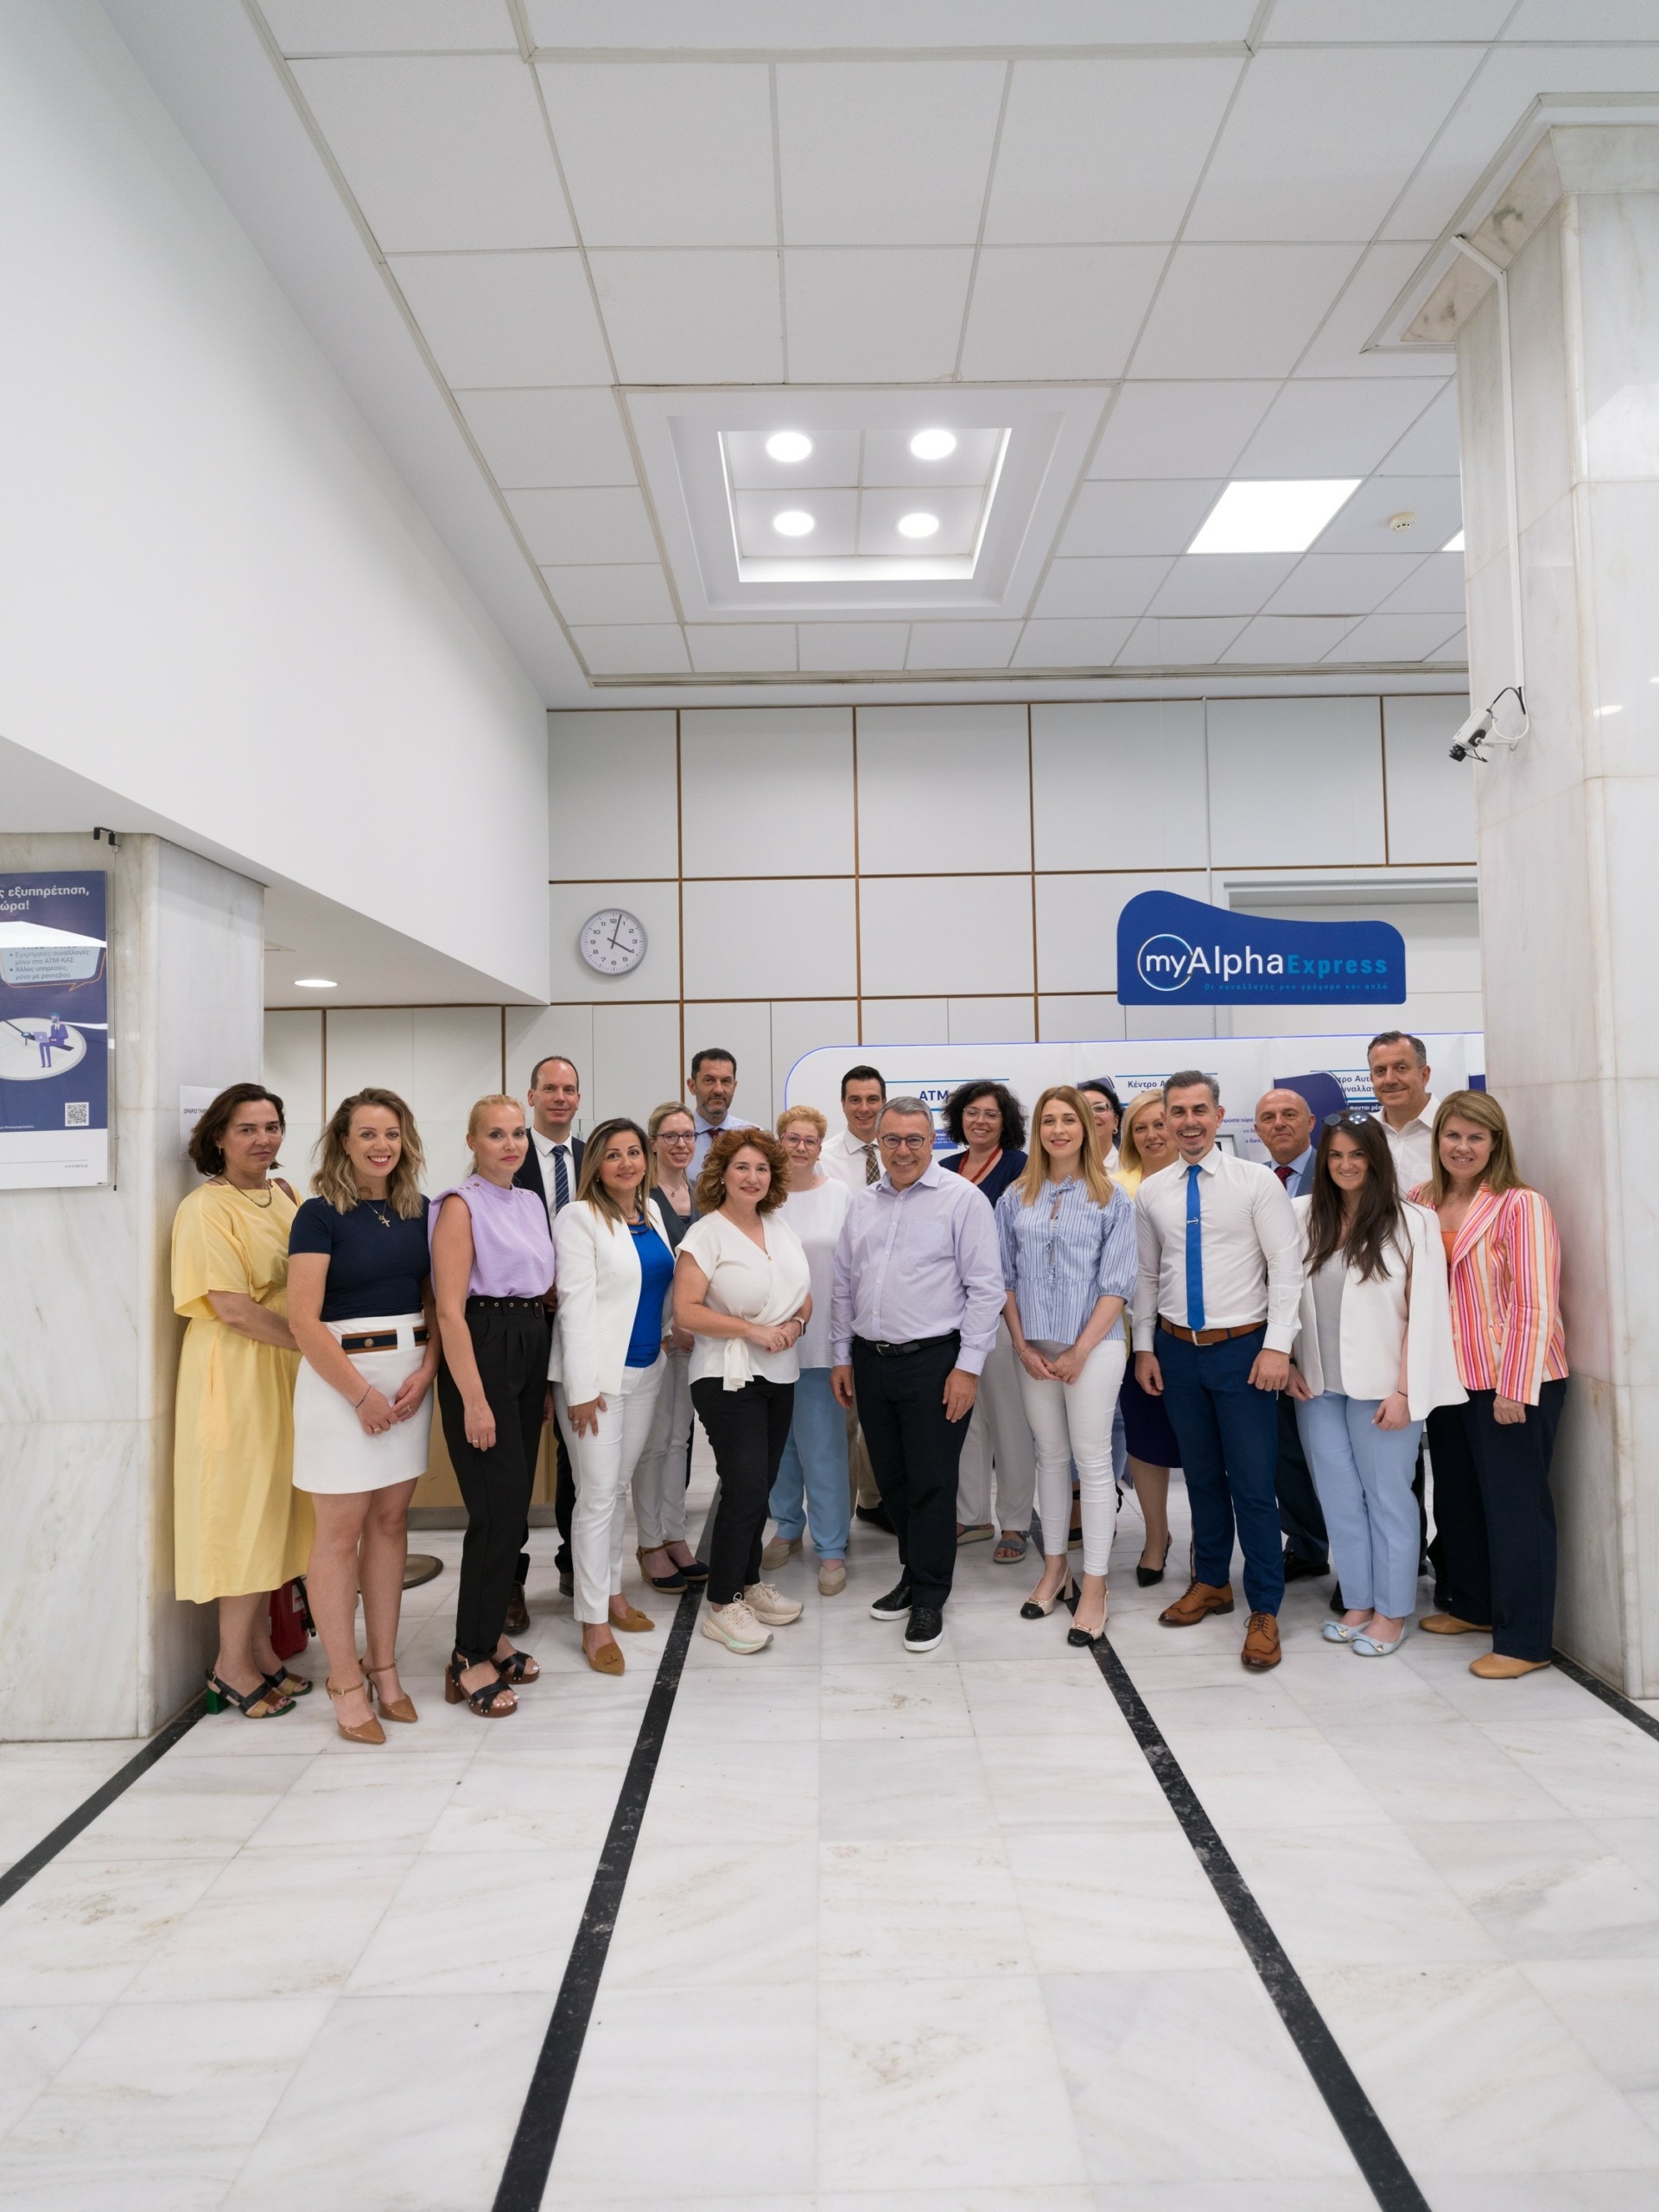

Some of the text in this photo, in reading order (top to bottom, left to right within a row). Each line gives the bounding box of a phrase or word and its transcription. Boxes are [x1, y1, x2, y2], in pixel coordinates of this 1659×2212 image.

[8, 885, 90, 899] εξυπηρέτηση,
[0, 899, 29, 912] ώρα!
[1146, 945, 1388, 982] myAlpha Express
[1128, 1080, 1157, 1089] Κέντρο
[918, 1090, 949, 1102] ATM
